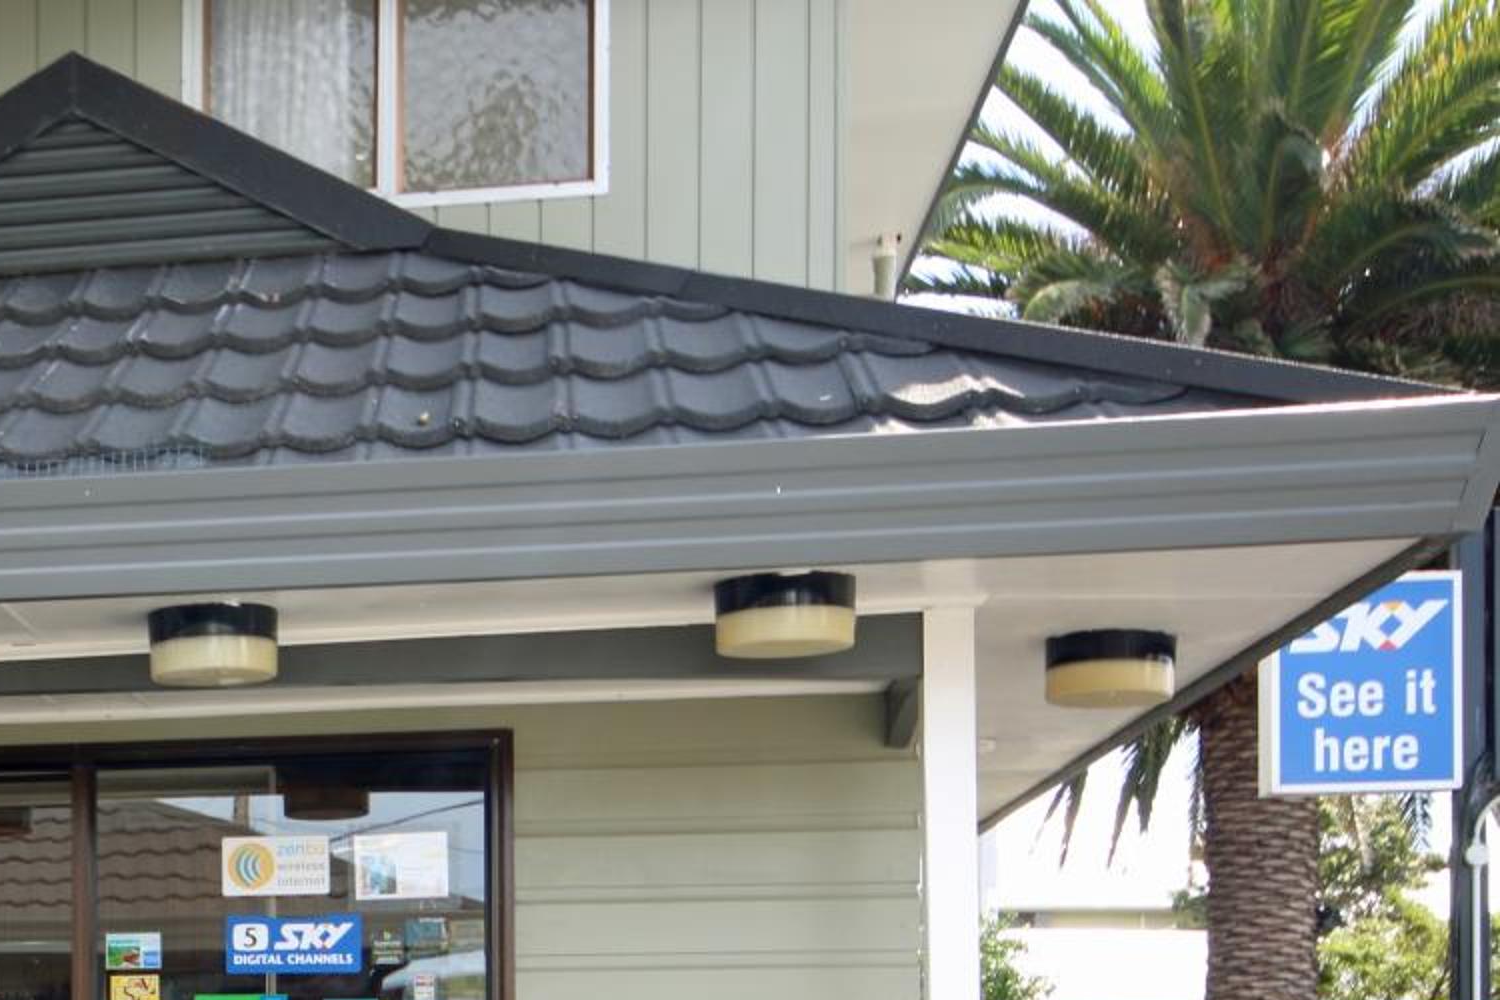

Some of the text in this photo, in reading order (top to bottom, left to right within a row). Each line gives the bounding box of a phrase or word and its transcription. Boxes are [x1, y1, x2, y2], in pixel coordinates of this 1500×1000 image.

[1289, 599, 1449, 655] SKY
[1296, 668, 1437, 719] See it
[1313, 727, 1420, 772] here
[232, 952, 354, 965] DIGITAL CHANNELS
[243, 922, 354, 950] 5 SKY
